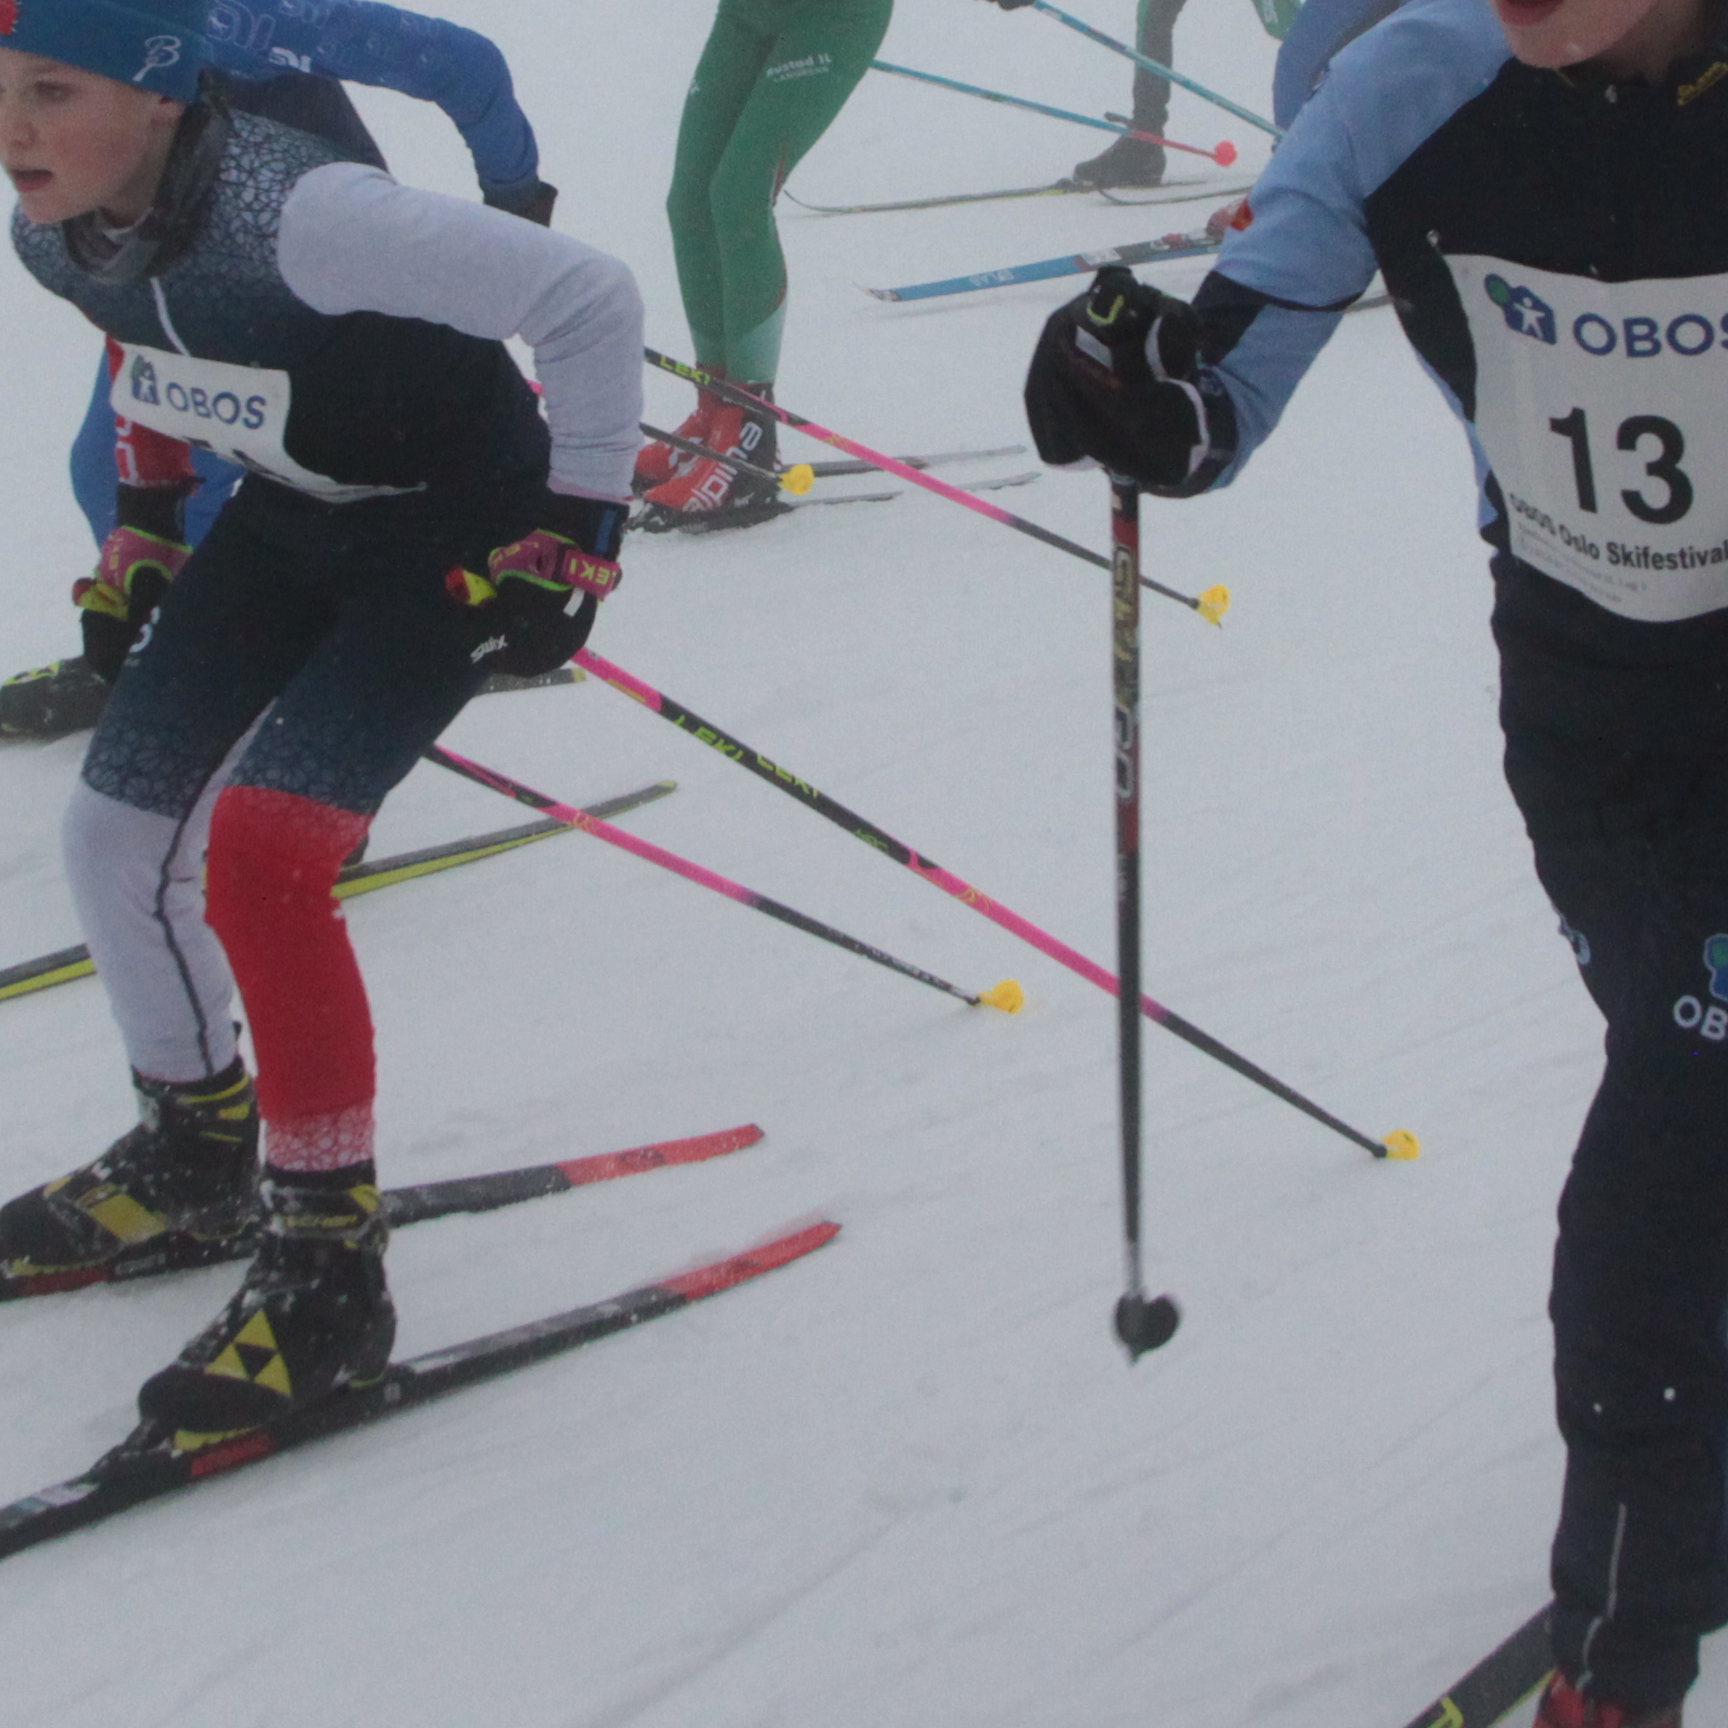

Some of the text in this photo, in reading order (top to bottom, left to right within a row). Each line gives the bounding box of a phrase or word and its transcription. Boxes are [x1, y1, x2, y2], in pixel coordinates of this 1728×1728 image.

[659, 355, 711, 386] LEKI
[166, 382, 268, 430] OBOS
[1549, 407, 1694, 525] 13
[1558, 523, 1601, 561] Oslo
[569, 558, 618, 587] EKI
